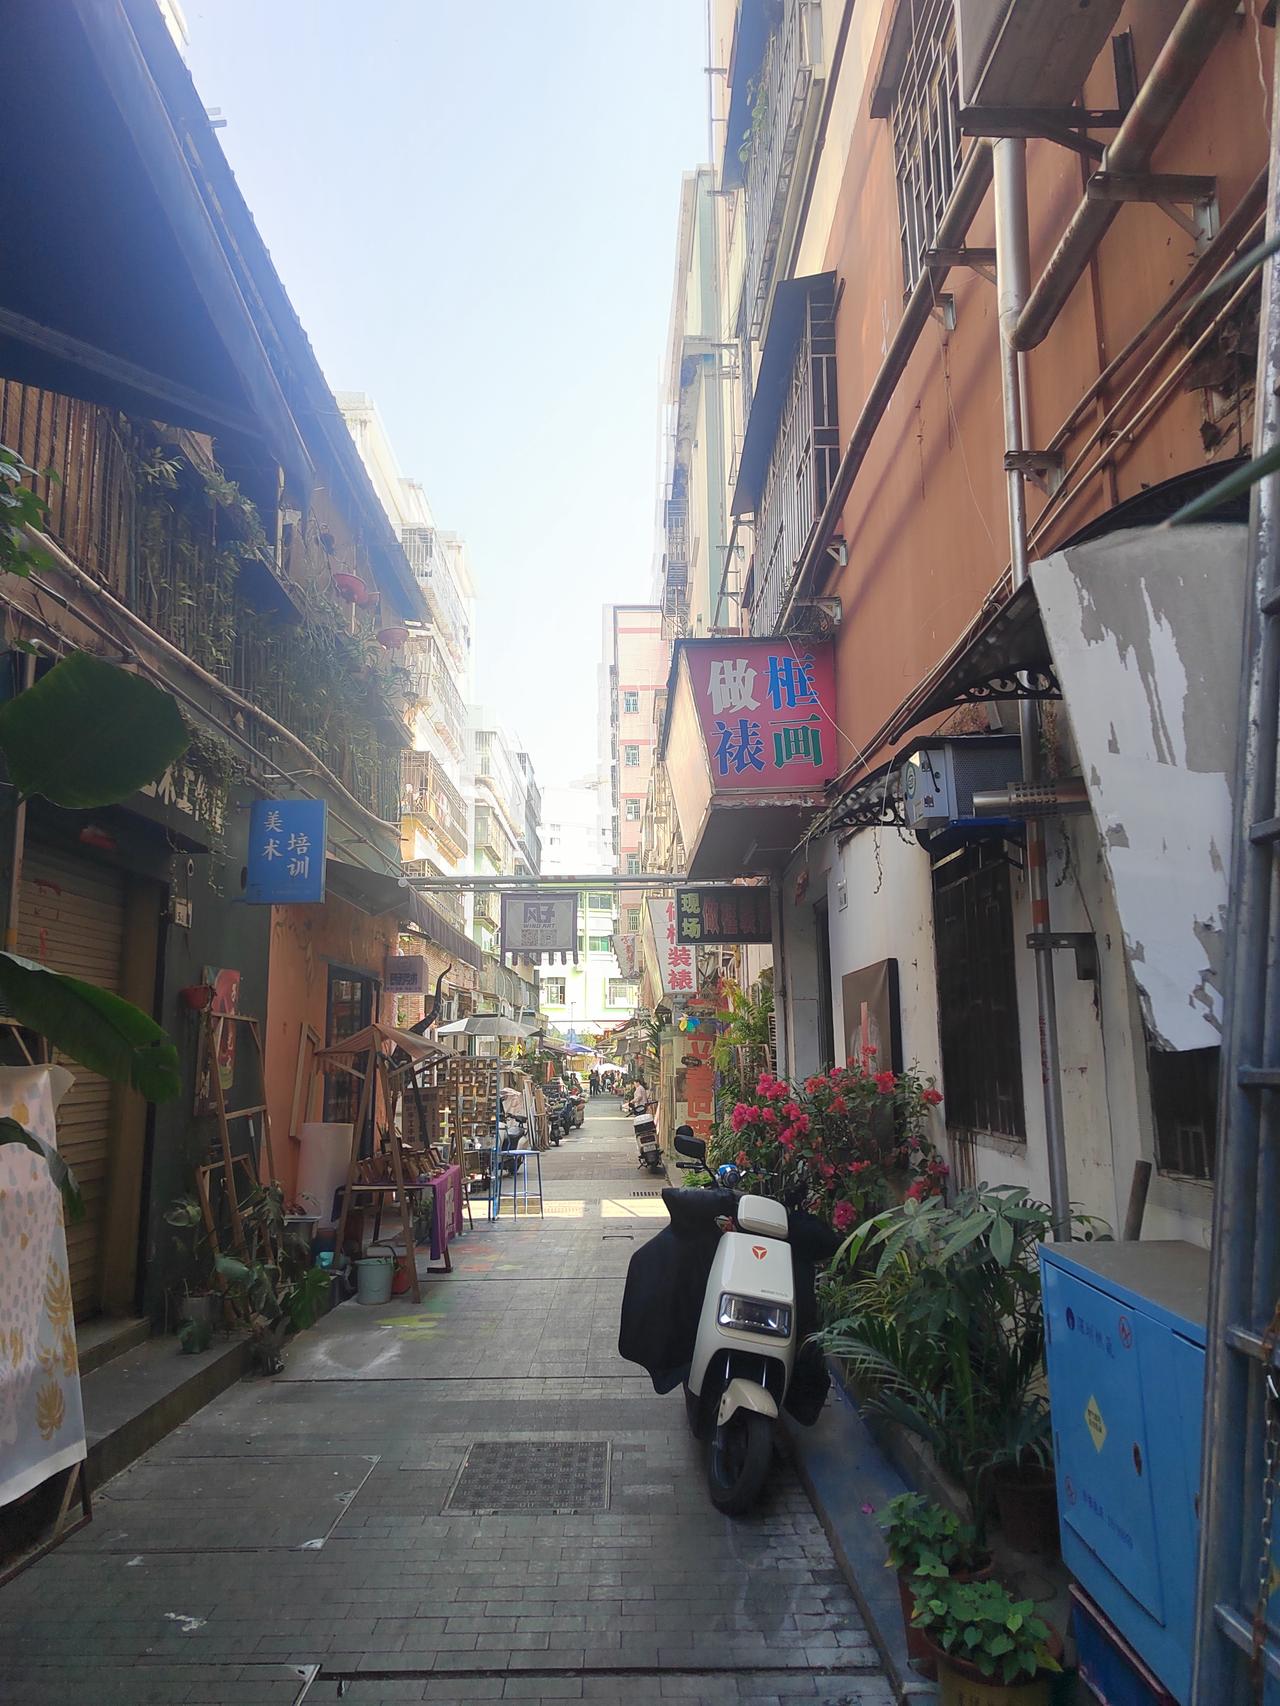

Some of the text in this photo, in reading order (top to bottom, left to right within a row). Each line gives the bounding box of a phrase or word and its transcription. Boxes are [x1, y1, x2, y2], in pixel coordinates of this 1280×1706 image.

[706, 655, 819, 715] 做框
[711, 713, 824, 775] 裱画
[262, 810, 284, 861] 美术
[287, 832, 312, 879] 培训
[680, 892, 701, 940] 现场
